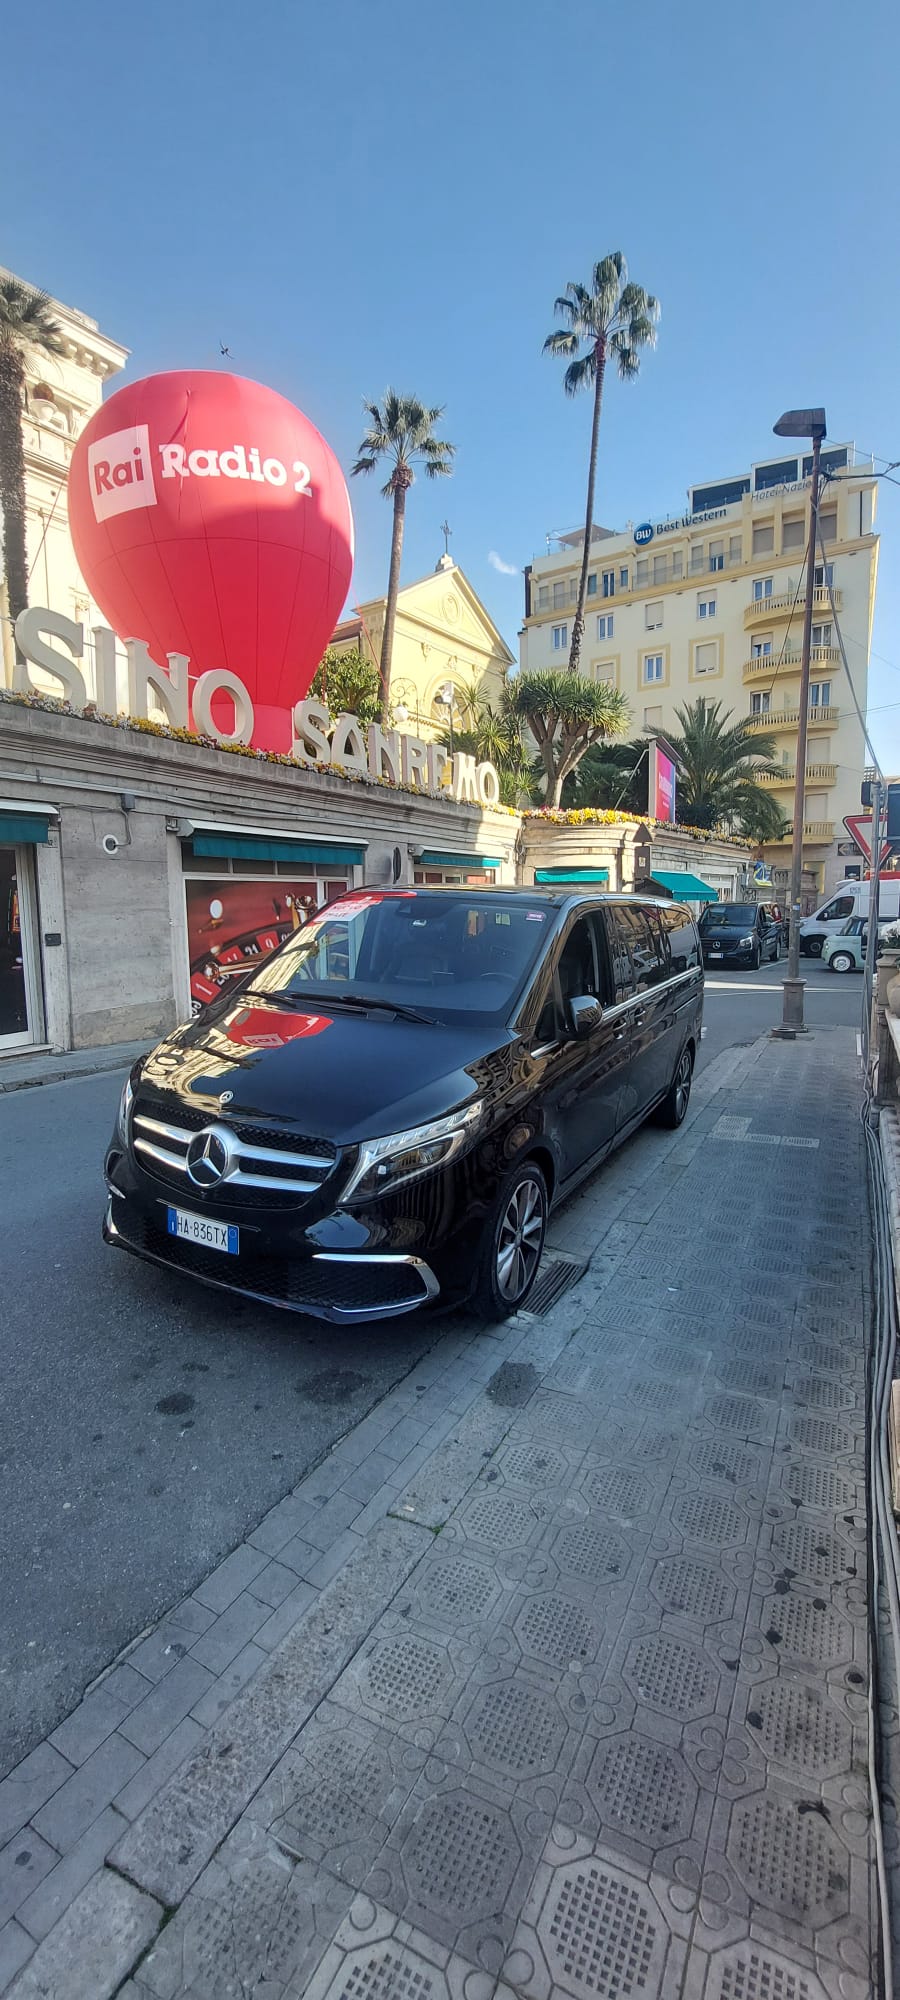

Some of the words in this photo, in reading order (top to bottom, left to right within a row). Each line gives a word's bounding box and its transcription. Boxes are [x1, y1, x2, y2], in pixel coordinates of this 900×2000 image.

[94, 447, 145, 496] Rai
[158, 443, 288, 487] Radio
[292, 461, 313, 498] 2
[751, 487, 779, 502] Hotel
[635, 528, 651, 542] BW
[656, 521, 679, 535] Best
[682, 508, 727, 527] Western
[13, 606, 255, 749] SINO
